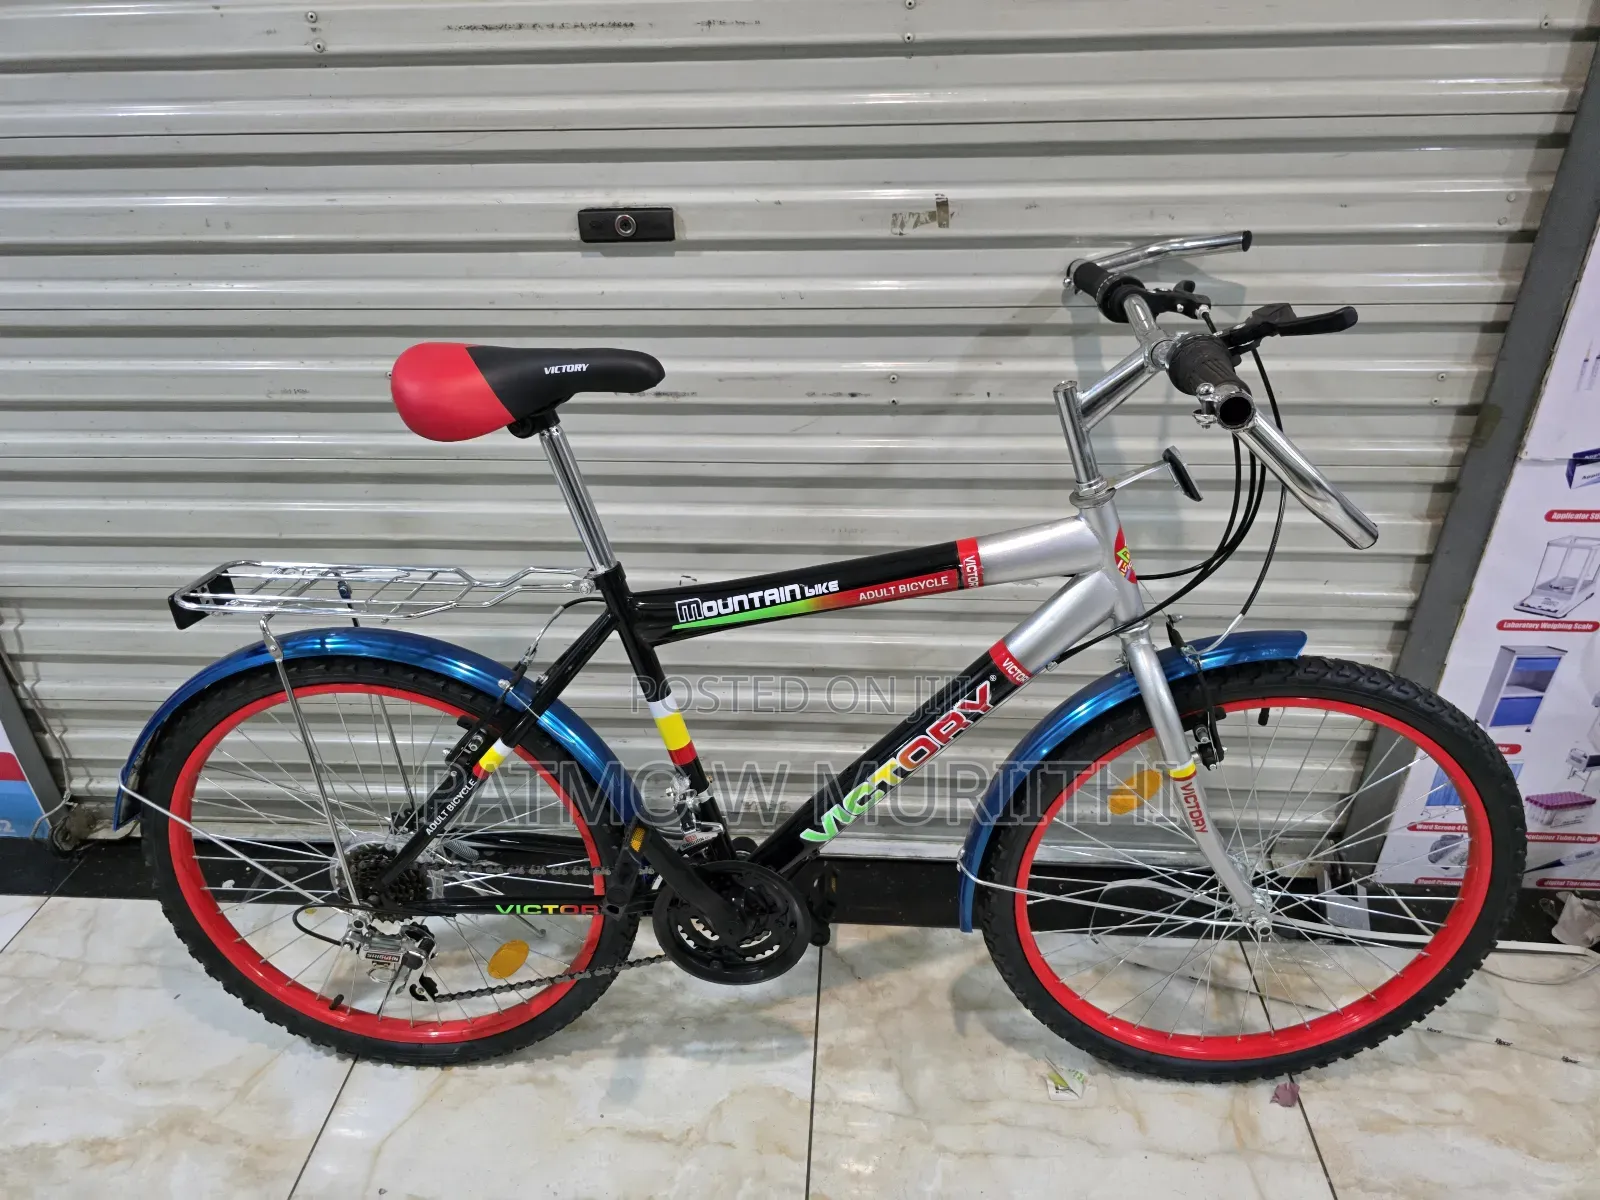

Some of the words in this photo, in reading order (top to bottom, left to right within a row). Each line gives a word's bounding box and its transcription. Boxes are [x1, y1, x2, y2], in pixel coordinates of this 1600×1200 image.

[543, 363, 590, 375] VICTORY
[1551, 512, 1590, 521] Applicator
[859, 586, 896, 601] ADULT
[898, 575, 949, 594] BICYCLE
[675, 583, 801, 623] MOUNTAIN
[1503, 621, 1540, 630] Laboratory
[799, 680, 995, 843] VICTORY
[425, 809, 449, 836] ADULT
[446, 778, 478, 812] BICYCLE
[1180, 781, 1209, 833] VICTORY
[1576, 835, 1599, 843] Purple
[495, 904, 600, 915] VICTOR
